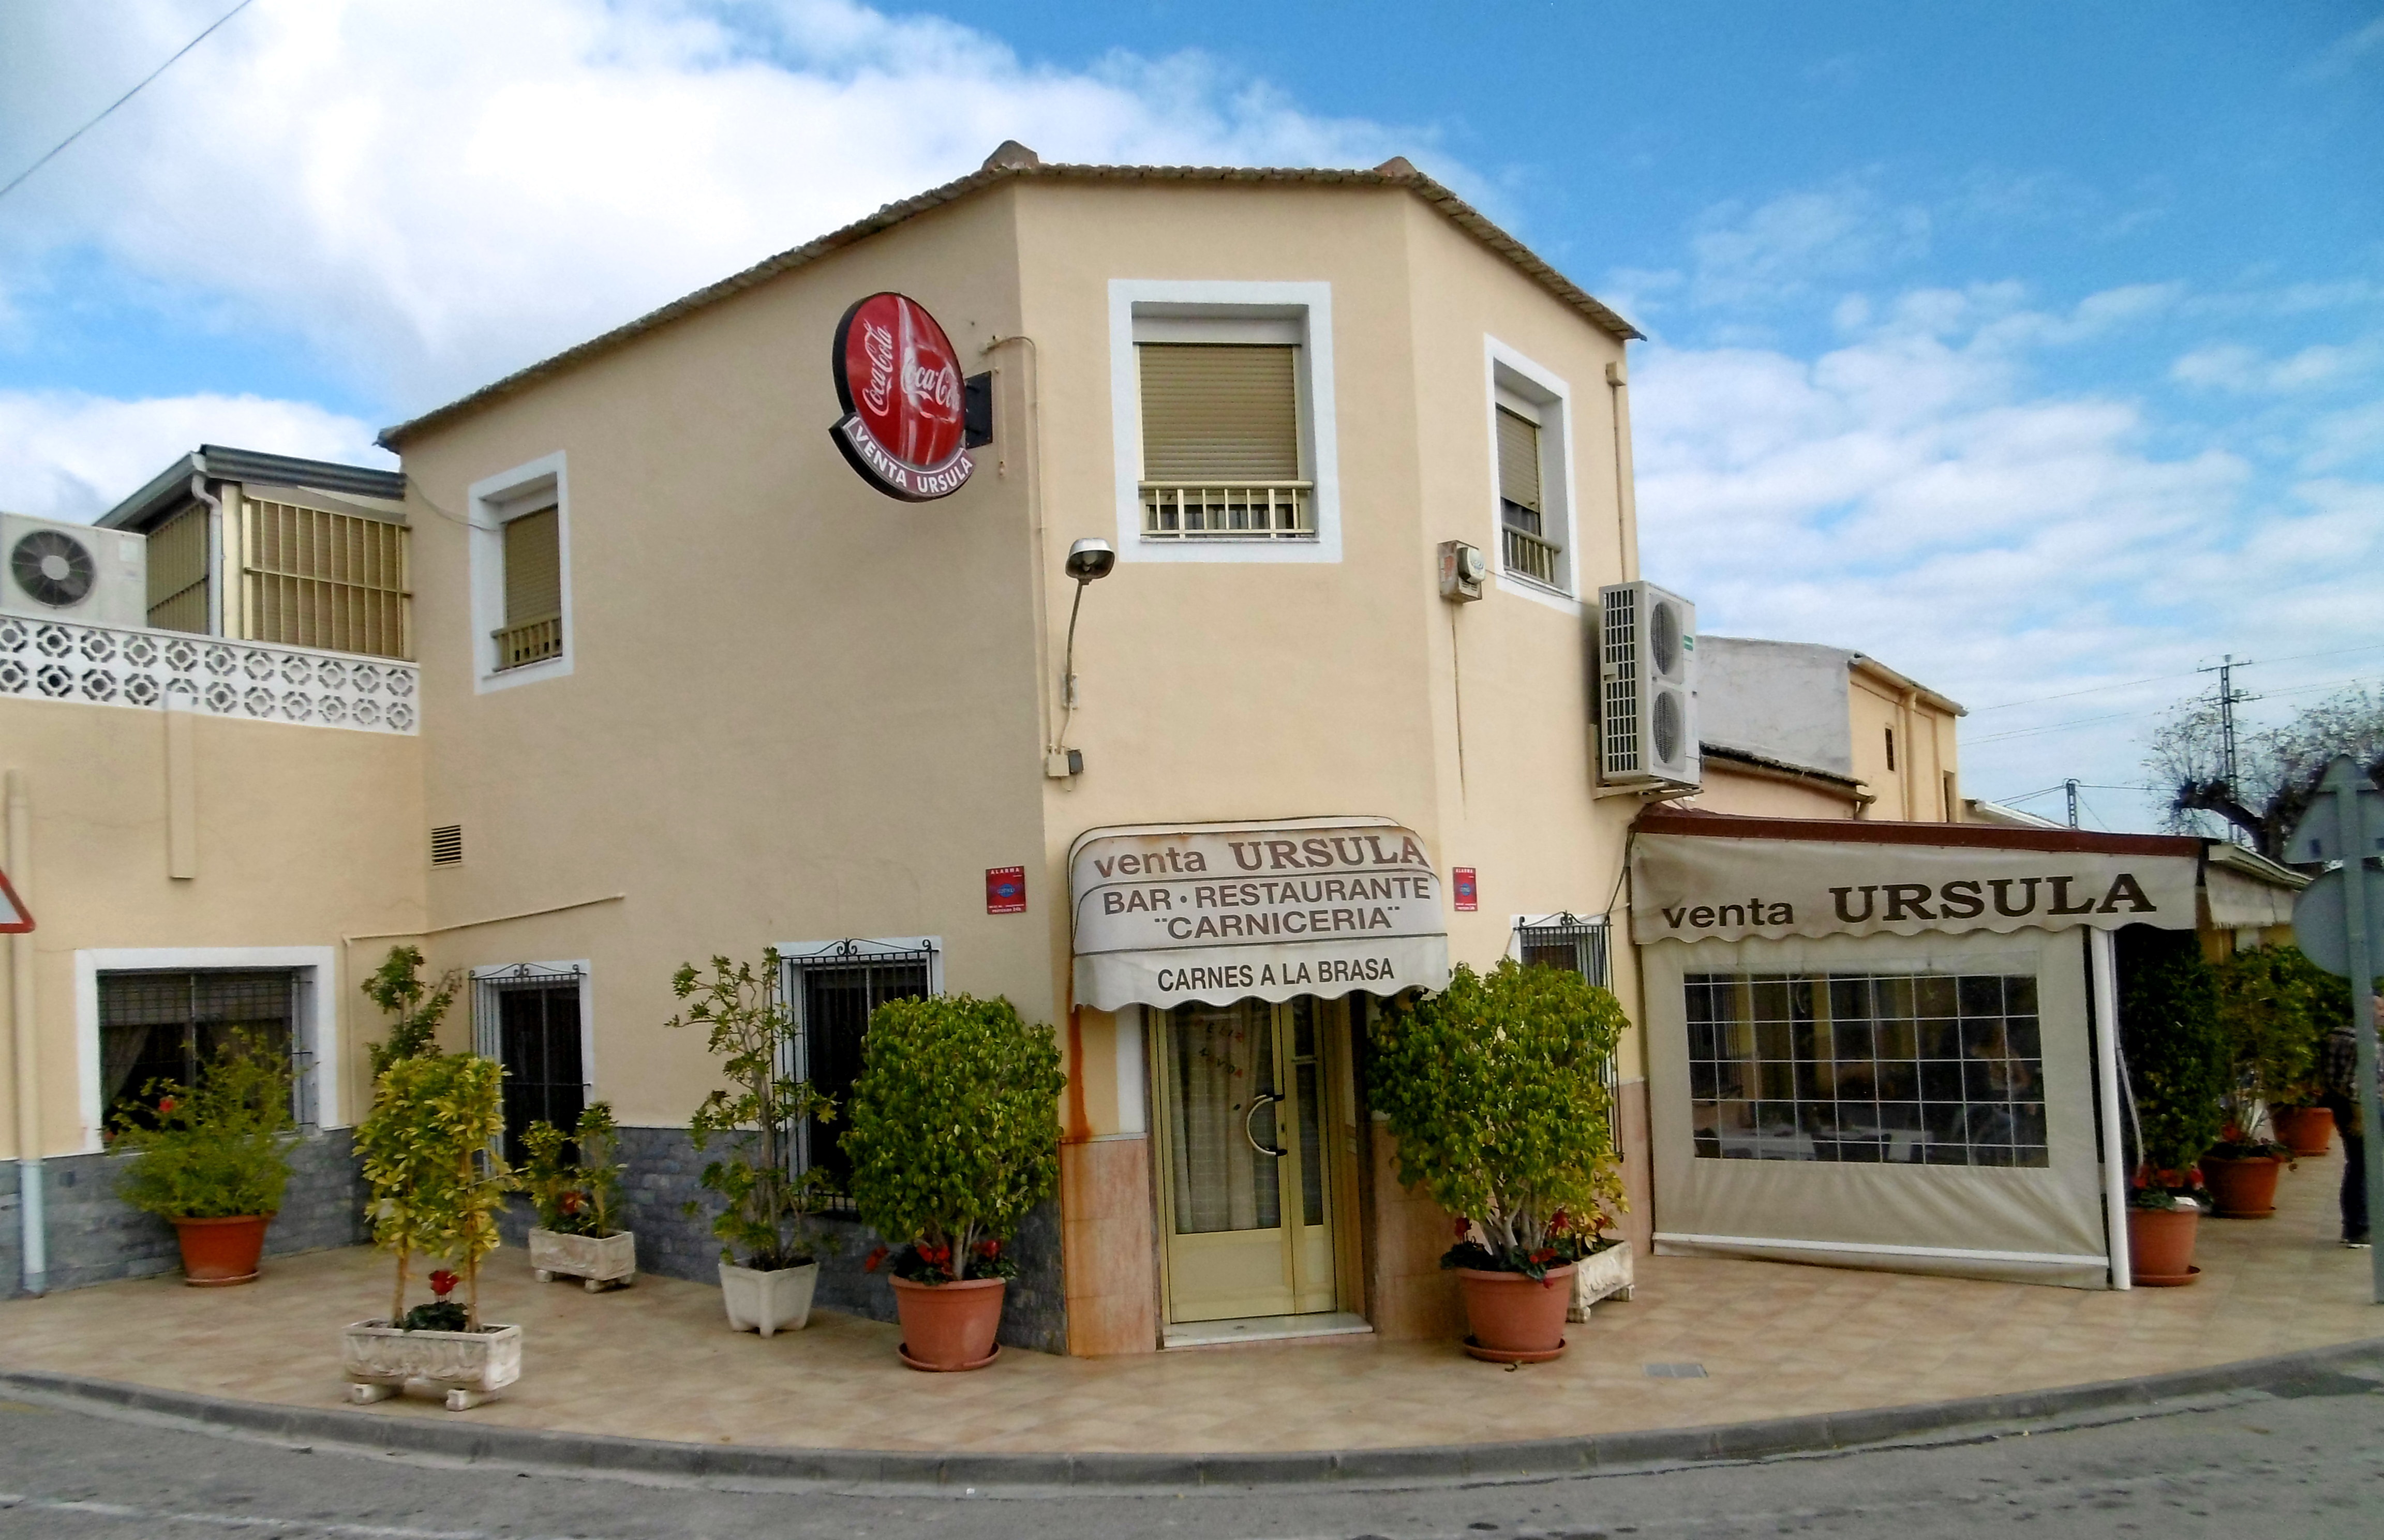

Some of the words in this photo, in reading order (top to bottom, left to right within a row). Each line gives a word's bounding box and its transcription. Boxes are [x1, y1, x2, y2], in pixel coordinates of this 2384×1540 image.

[854, 425, 907, 487] VENTA
[917, 456, 973, 493] URSULA
[1094, 846, 1206, 878] venta
[1228, 835, 1430, 872] URSULA
[1103, 888, 1172, 915] BAR
[1195, 877, 1431, 908] RESTAURANTE
[1662, 898, 1794, 929] venta
[1829, 873, 2156, 924] URSULA
[1158, 964, 1253, 992] CARNES
[1260, 964, 1276, 985] A
[1283, 962, 1311, 984] LA
[1318, 958, 1395, 982] BRASA
